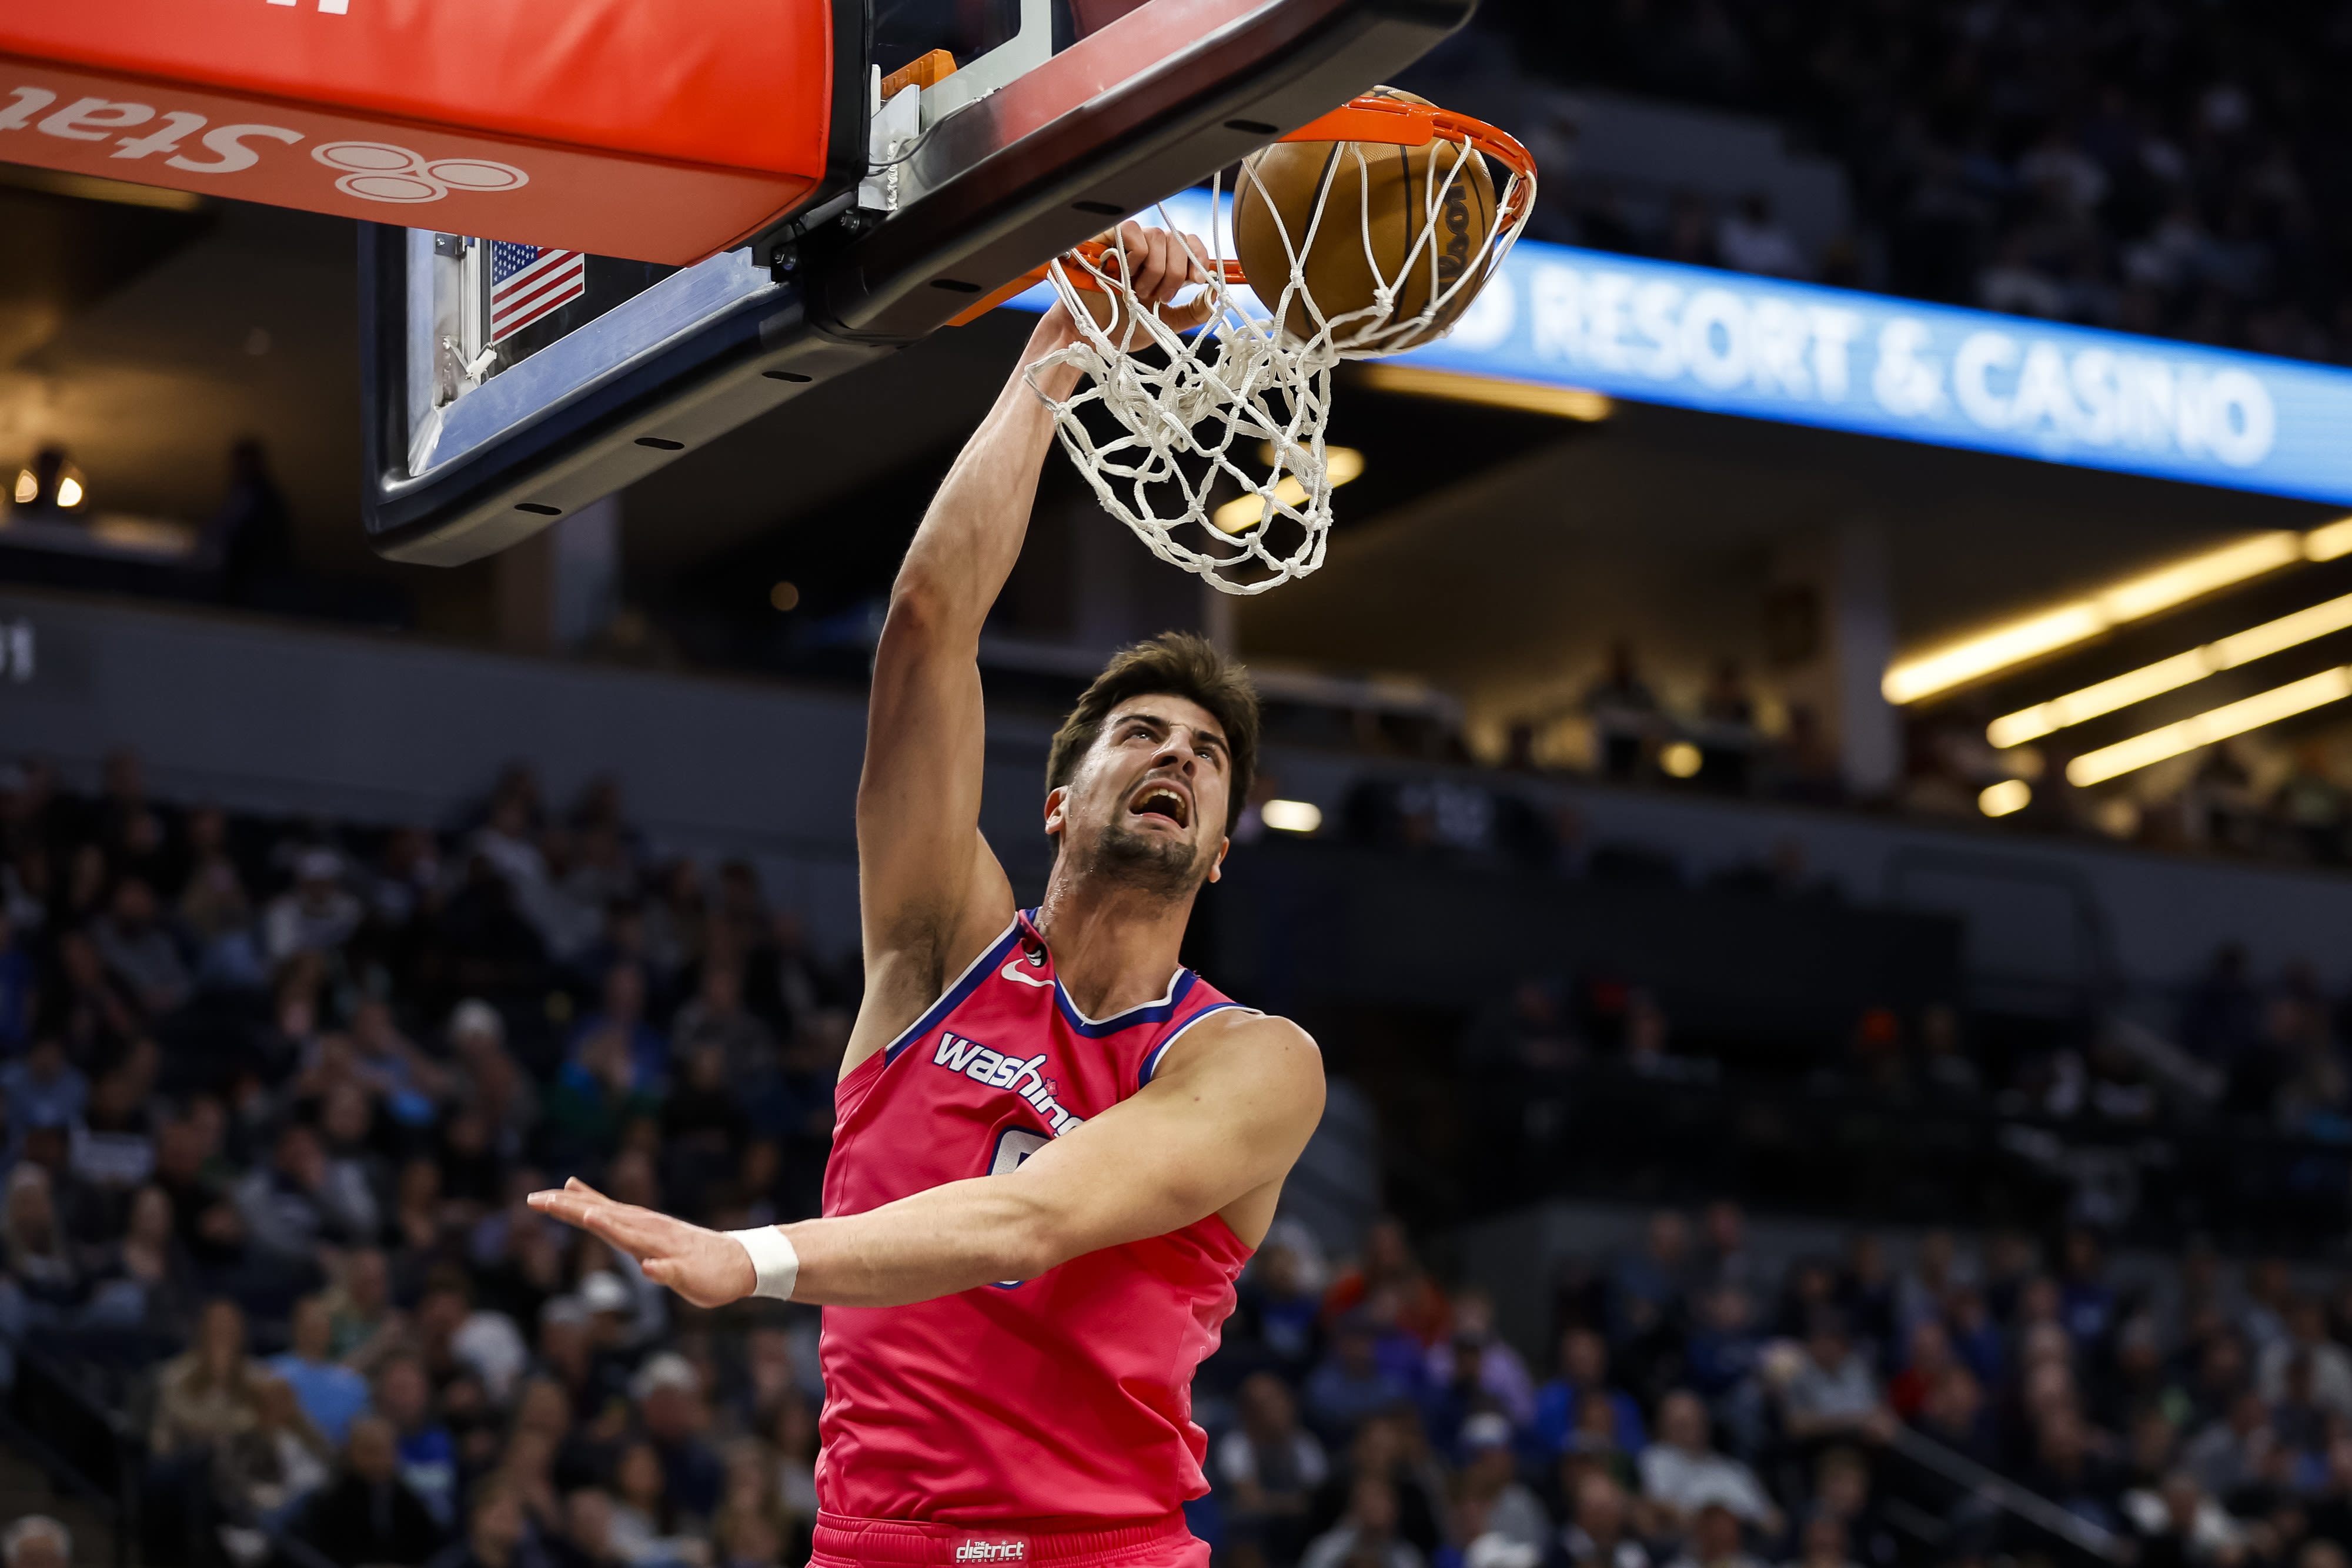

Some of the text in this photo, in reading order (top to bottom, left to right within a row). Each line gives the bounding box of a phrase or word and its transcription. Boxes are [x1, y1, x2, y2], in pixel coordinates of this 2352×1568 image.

[1532, 265, 1863, 404] RESORT
[1872, 317, 1947, 416] &
[1955, 331, 2276, 467] CASINO
[956, 1539, 1024, 1559] district
